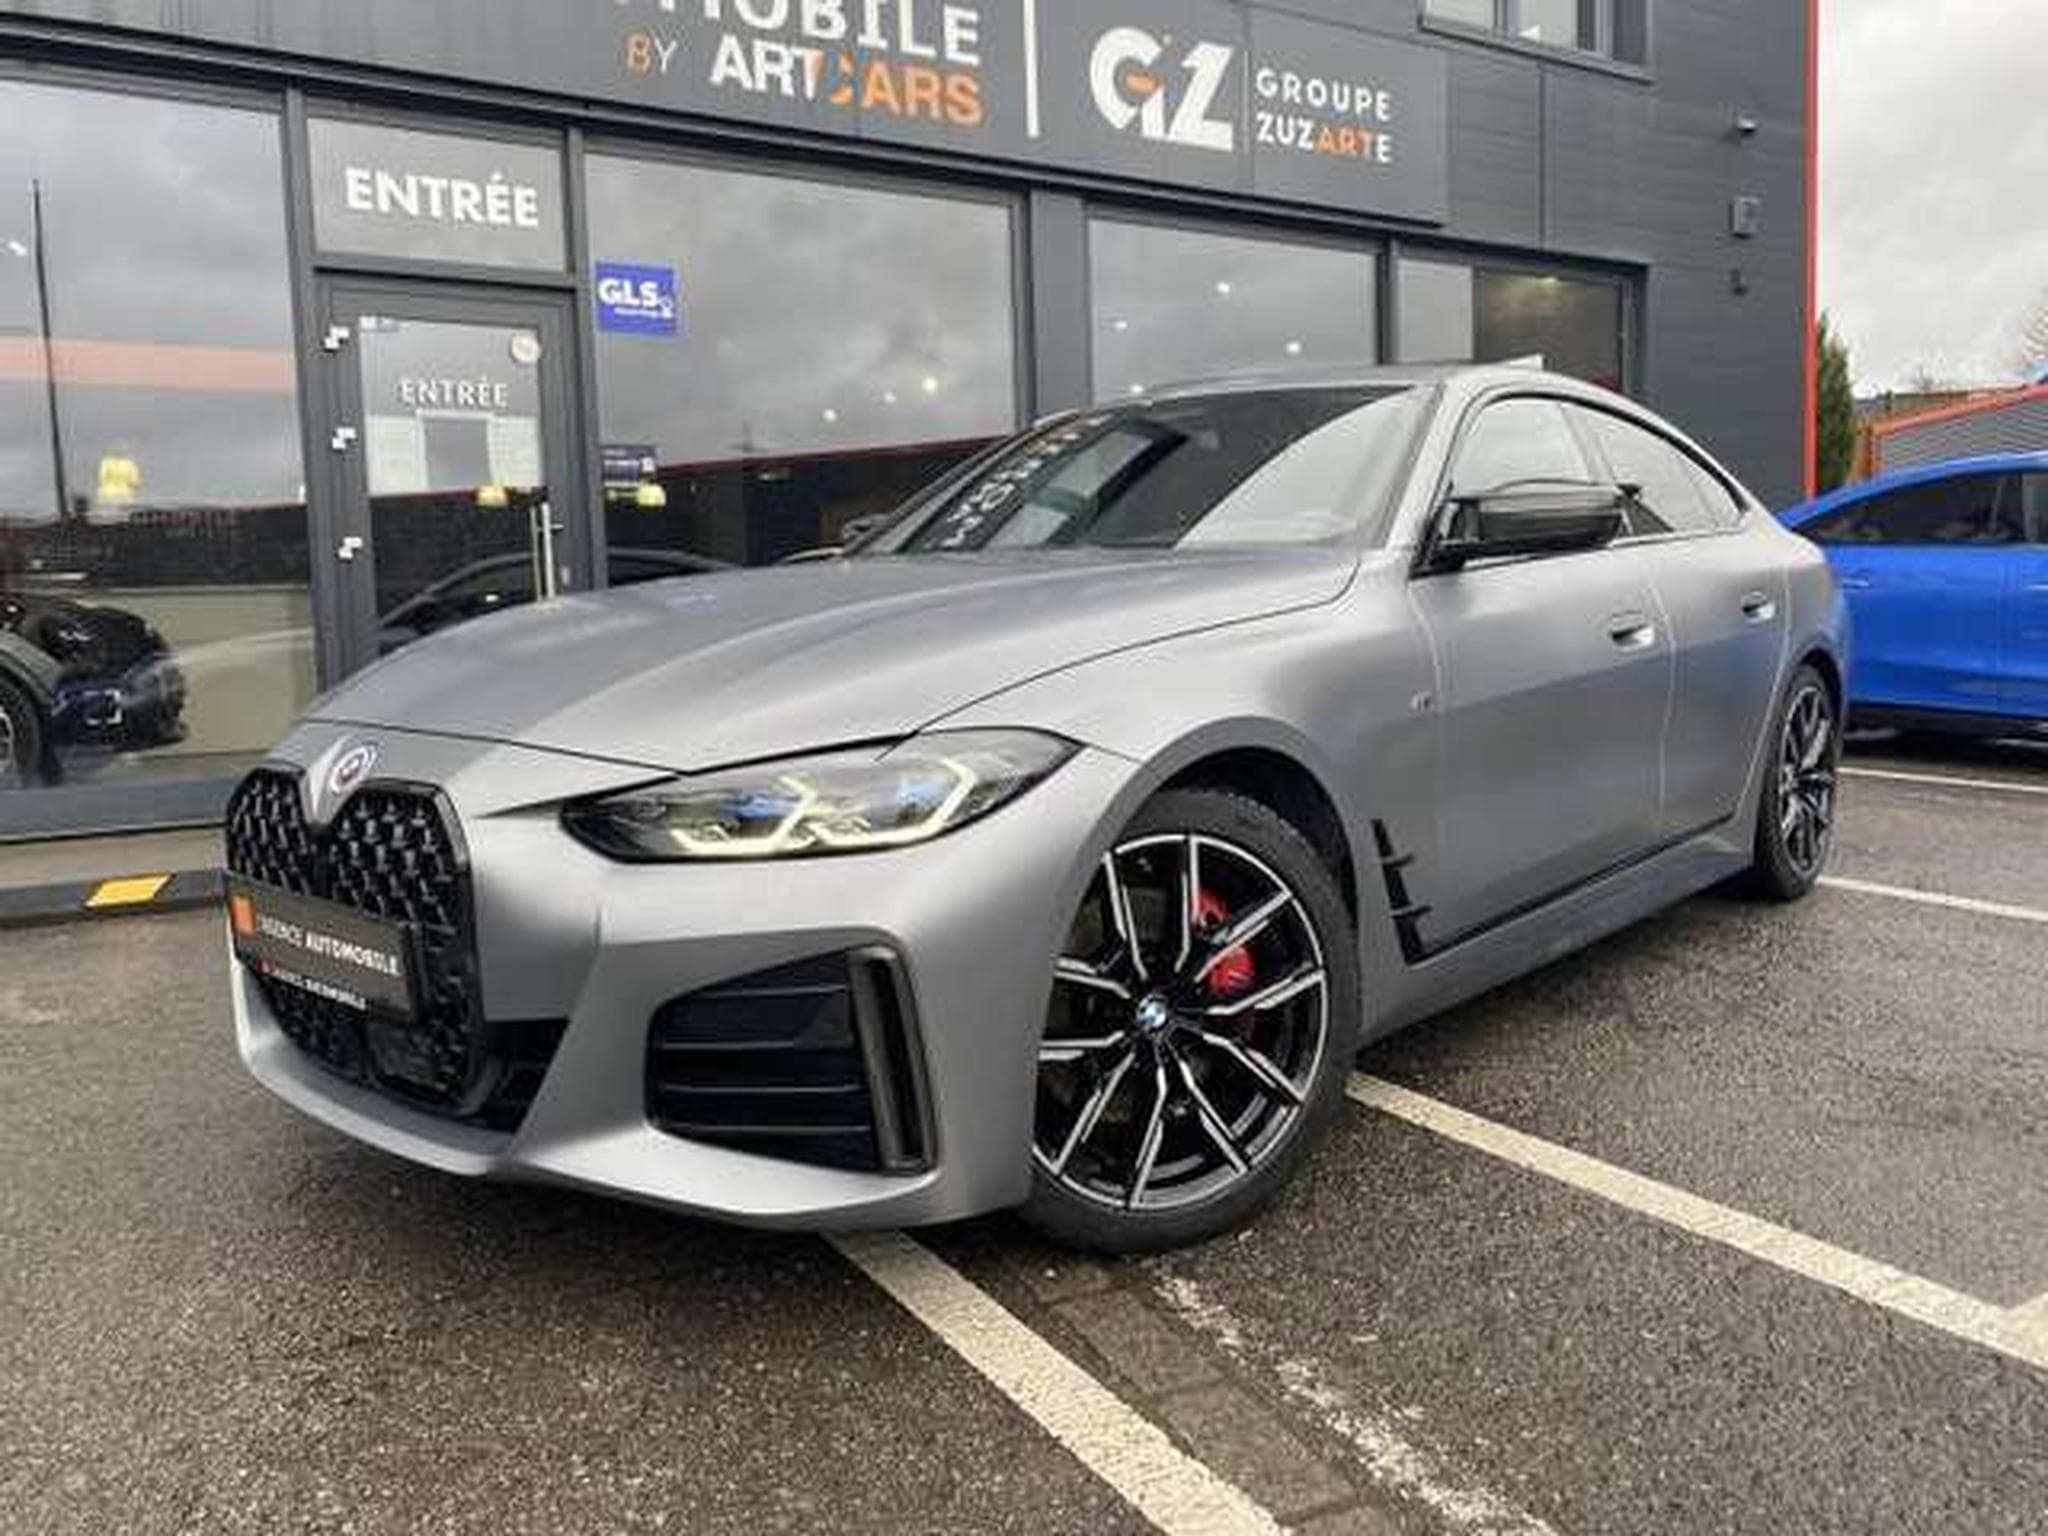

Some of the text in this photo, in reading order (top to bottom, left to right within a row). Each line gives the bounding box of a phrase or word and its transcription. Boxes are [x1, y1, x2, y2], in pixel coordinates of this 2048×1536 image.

[625, 30, 678, 75] BY
[1256, 67, 1389, 122] GROUPE
[1256, 111, 1391, 163] ZUZARTE
[345, 165, 539, 227] ENTRÉE
[599, 278, 658, 307] GLS
[401, 375, 508, 408] ENTRÉE
